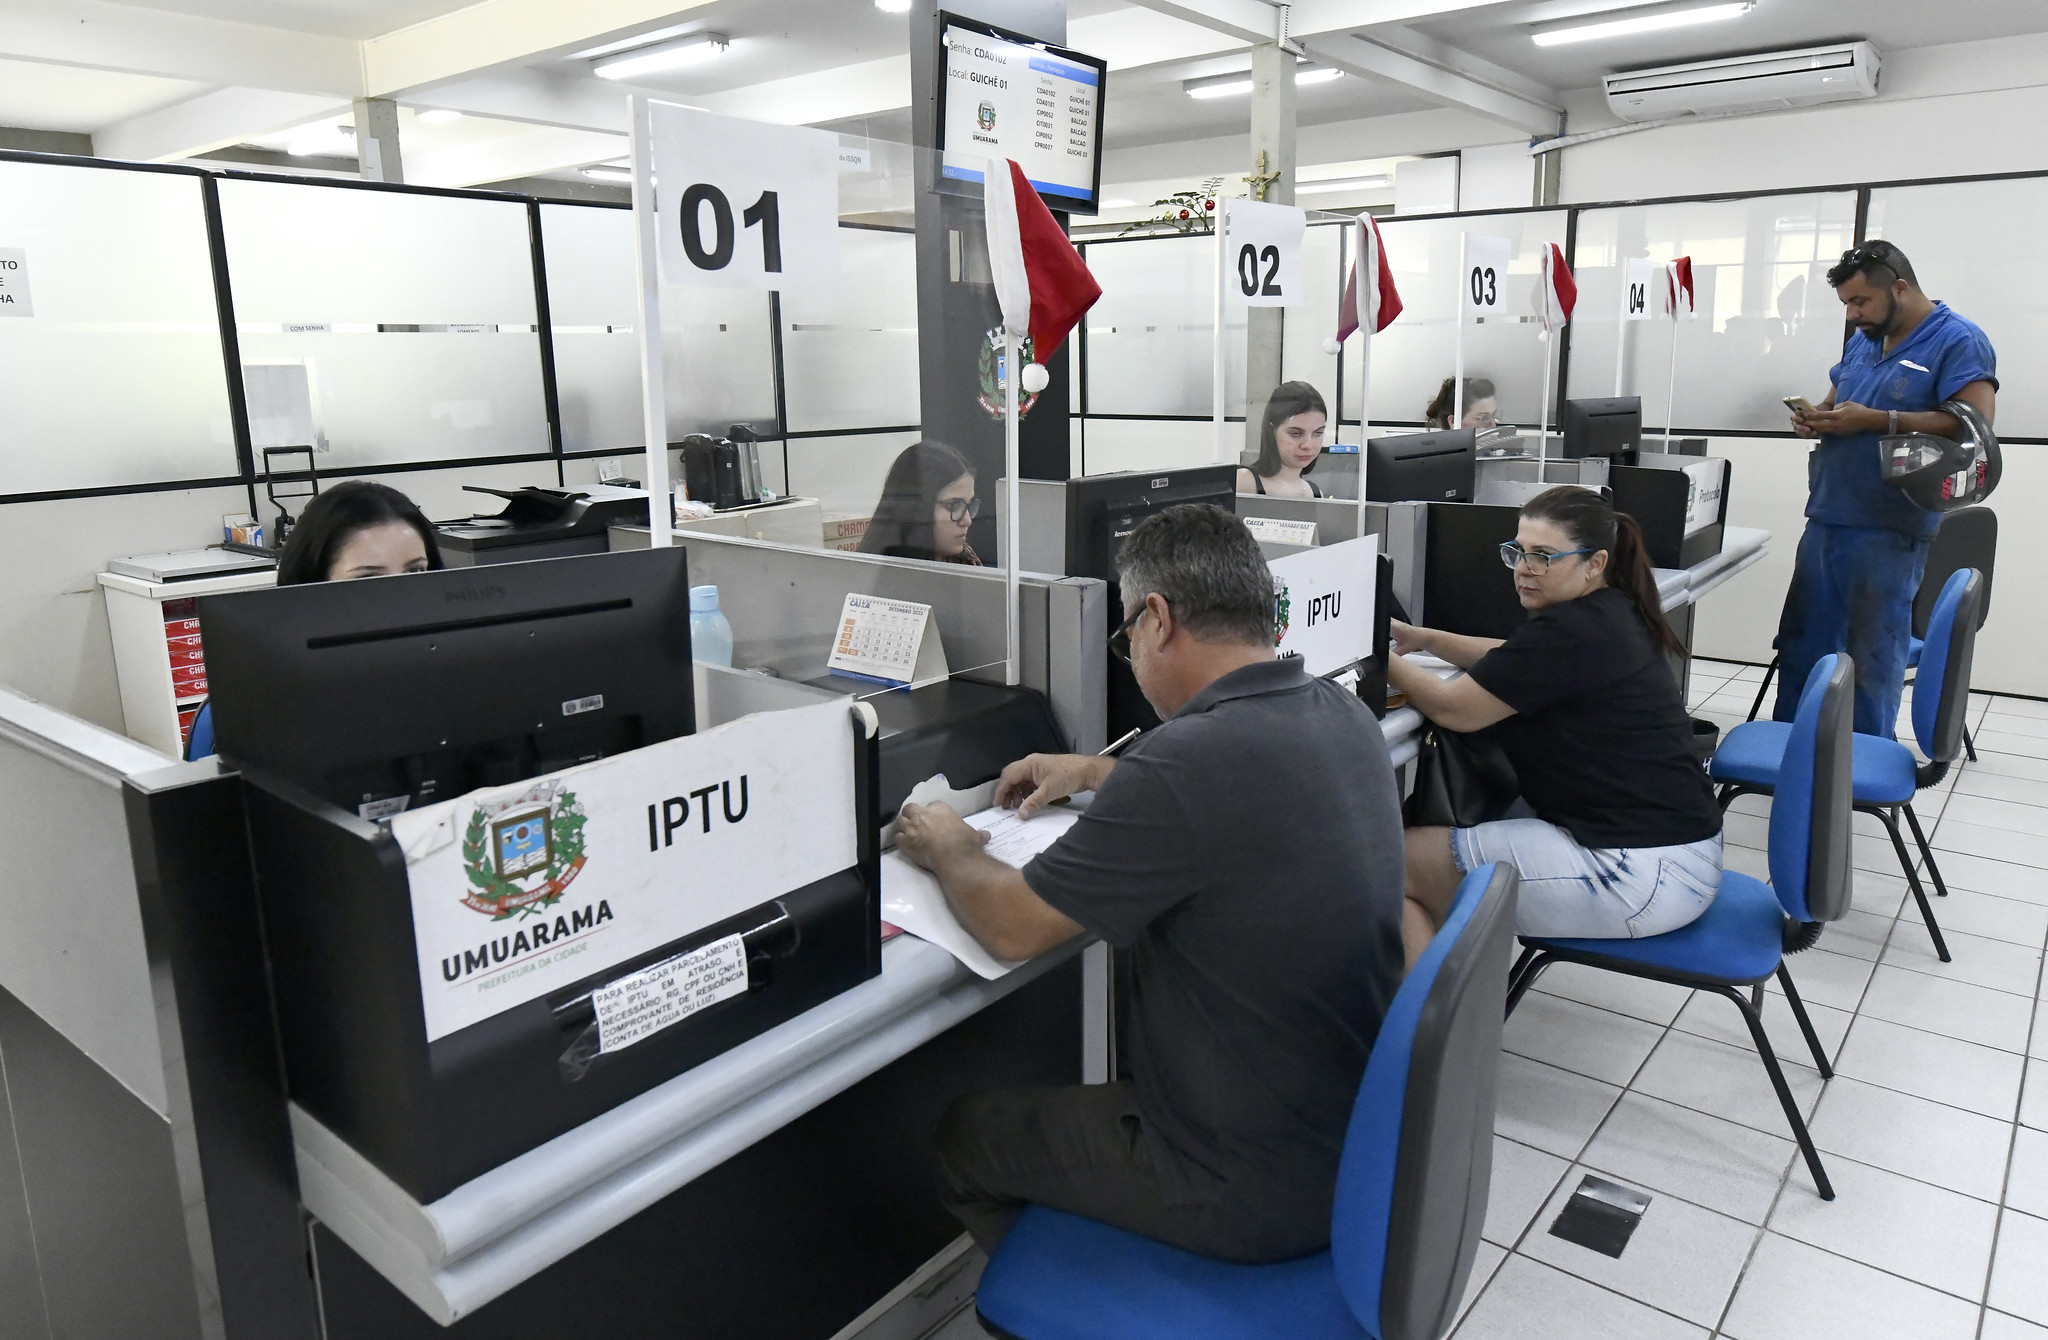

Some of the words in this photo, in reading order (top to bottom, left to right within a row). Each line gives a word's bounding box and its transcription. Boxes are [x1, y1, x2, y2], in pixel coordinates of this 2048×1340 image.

[950, 40, 972, 56] Senha:
[974, 48, 1006, 64] CDA0102
[948, 66, 968, 80] Local:
[970, 72, 998, 87] GUICHÊ
[1000, 80, 1008, 89] 01
[973, 134, 998, 144] UMUARAMA
[680, 183, 782, 273] 01
[1238, 243, 1282, 296] 02
[1471, 266, 1496, 306] 03
[1630, 283, 1644, 314] 04
[1308, 590, 1341, 627] IPTU
[648, 774, 748, 852] IPTU
[442, 900, 613, 982] UMUARAMA
[478, 964, 536, 992] PREFEITURA
[538, 958, 552, 969] DA
[554, 942, 588, 962] CIDADE
[596, 988, 623, 1002] PARA
[626, 968, 669, 991] REALIZAR
[671, 939, 739, 973] PARCELAMENTO
[684, 978, 700, 991] CPF
[703, 972, 715, 982] OU
[718, 963, 735, 975] CNH
[738, 959, 743, 967] E
[600, 1004, 613, 1016] DE
[628, 990, 648, 1004] IPTU
[662, 978, 674, 990] EM
[603, 1002, 672, 1038] COMPROVANTE
[679, 994, 689, 1005] DE
[696, 970, 744, 997] RESIDÊNCIA
[603, 1029, 638, 1049] (CONTA
[641, 1022, 652, 1032] DE
[683, 1003, 695, 1014] OU
